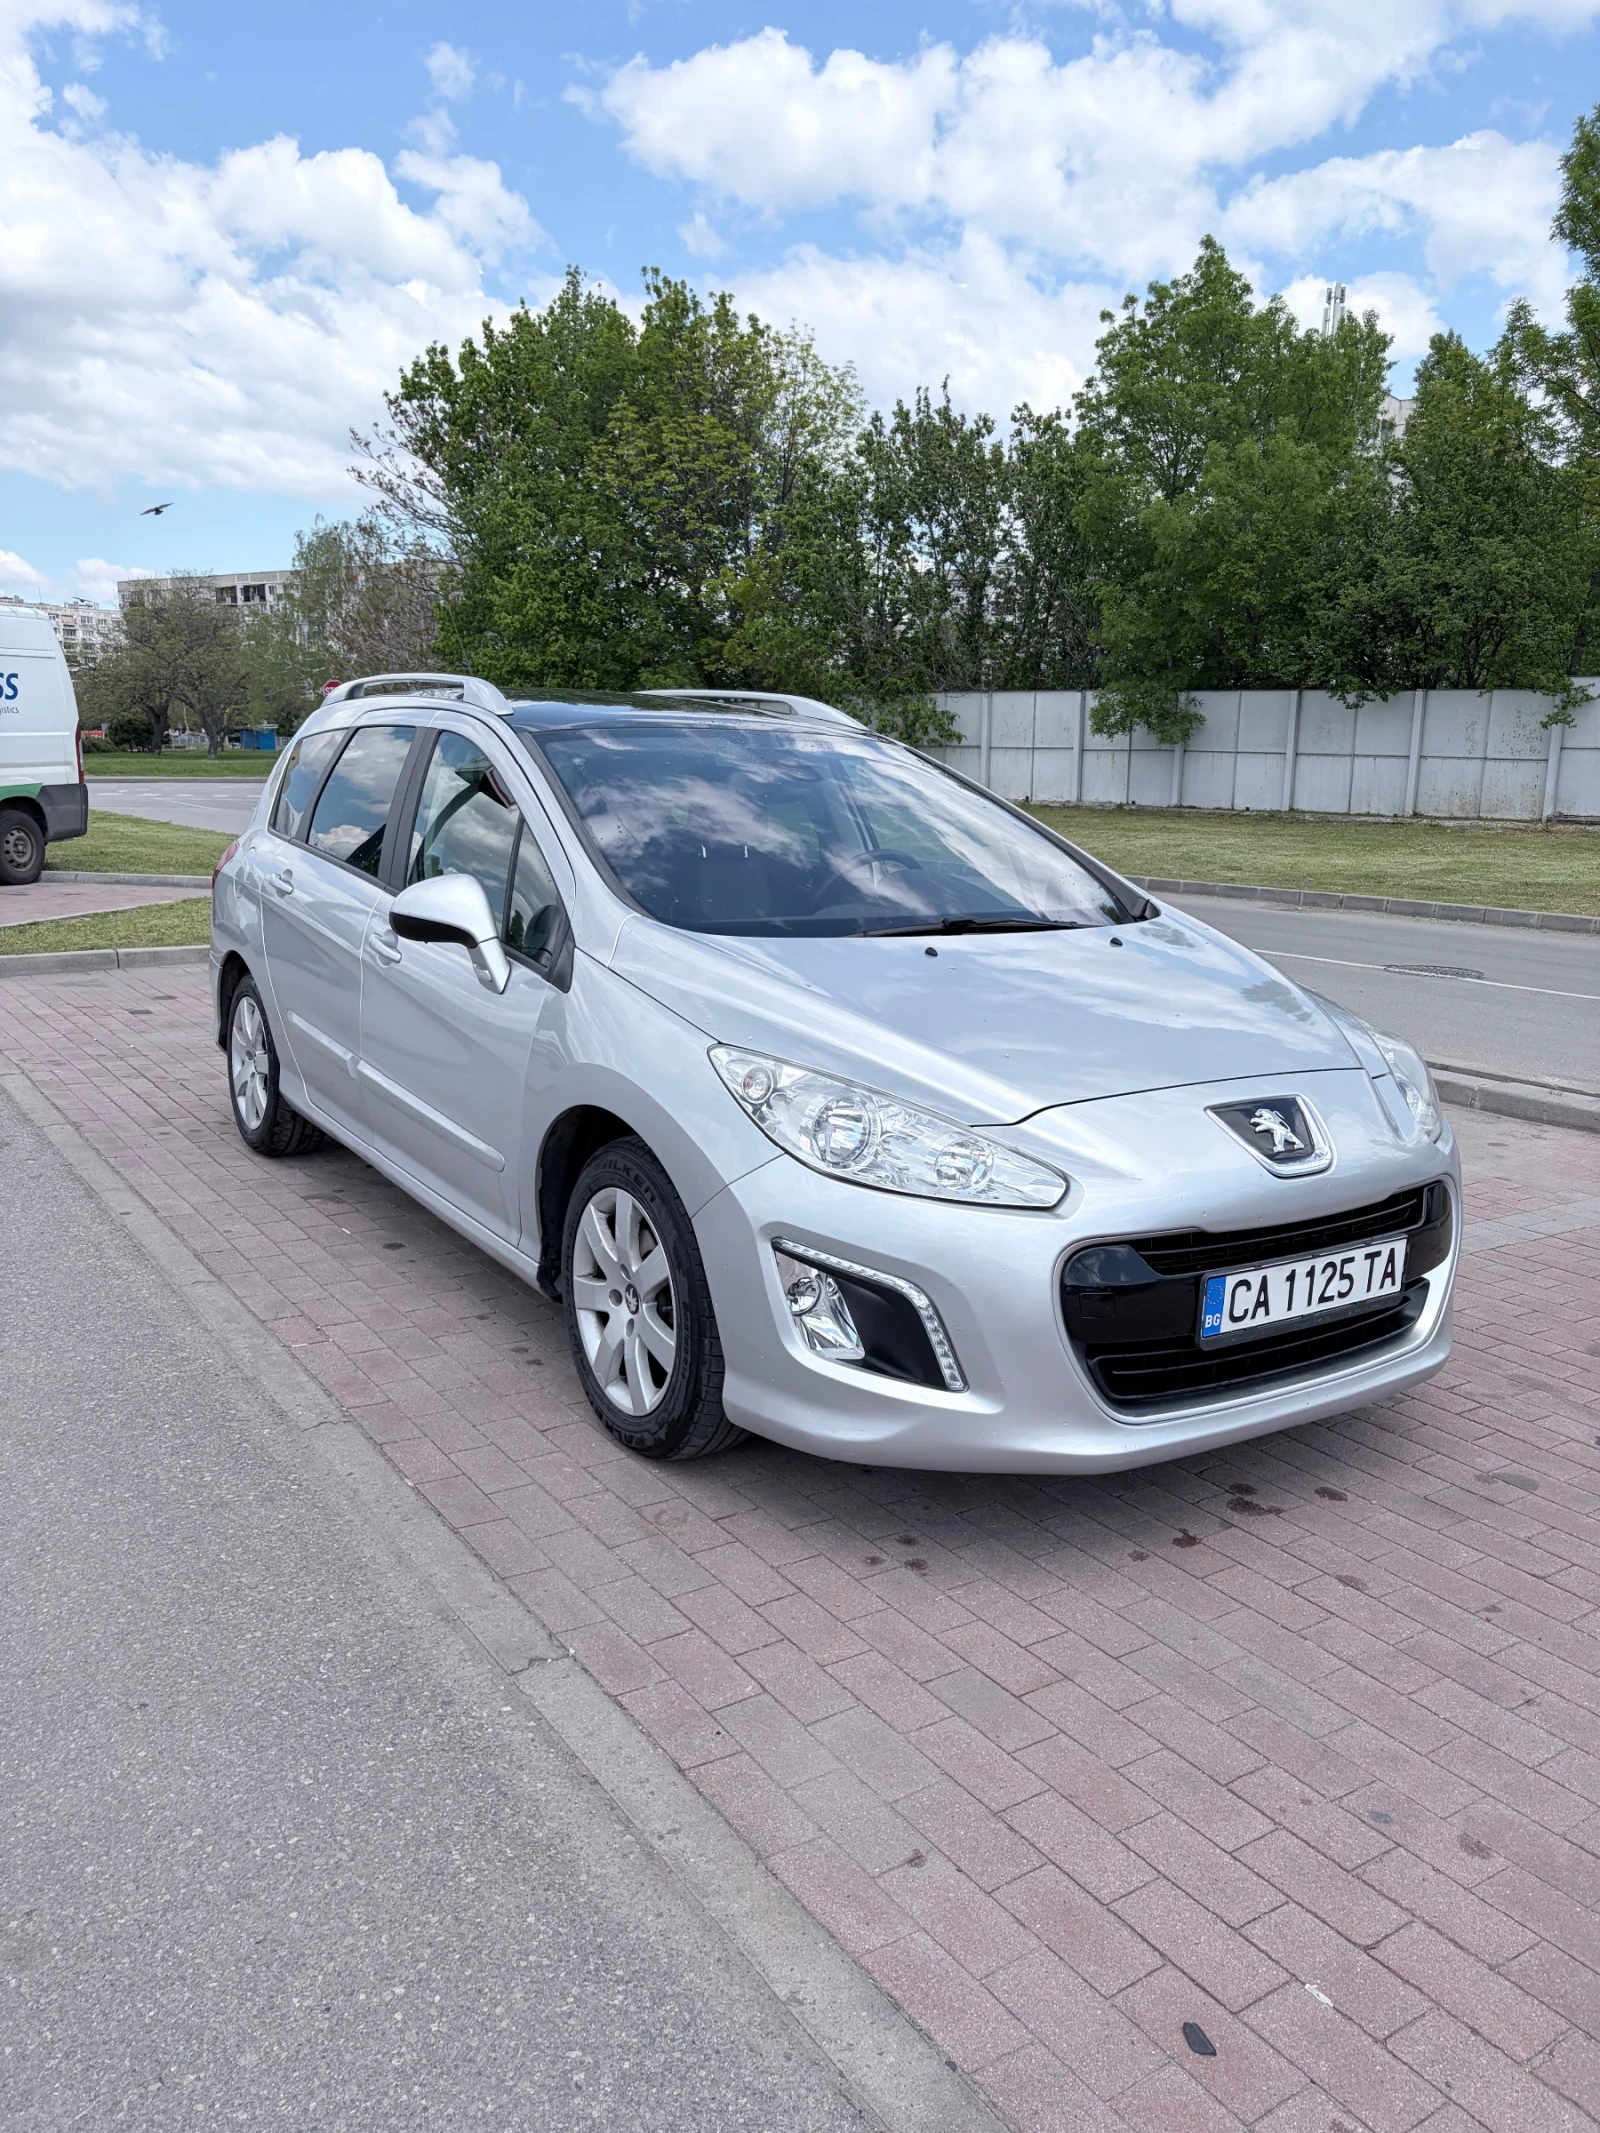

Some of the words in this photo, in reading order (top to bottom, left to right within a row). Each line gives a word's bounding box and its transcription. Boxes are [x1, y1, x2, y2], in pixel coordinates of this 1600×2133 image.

[1228, 1274, 1271, 1324] CA
[1285, 1256, 1356, 1312] 1125
[1364, 1247, 1397, 1293] TA
[1205, 1313, 1221, 1328] BG
